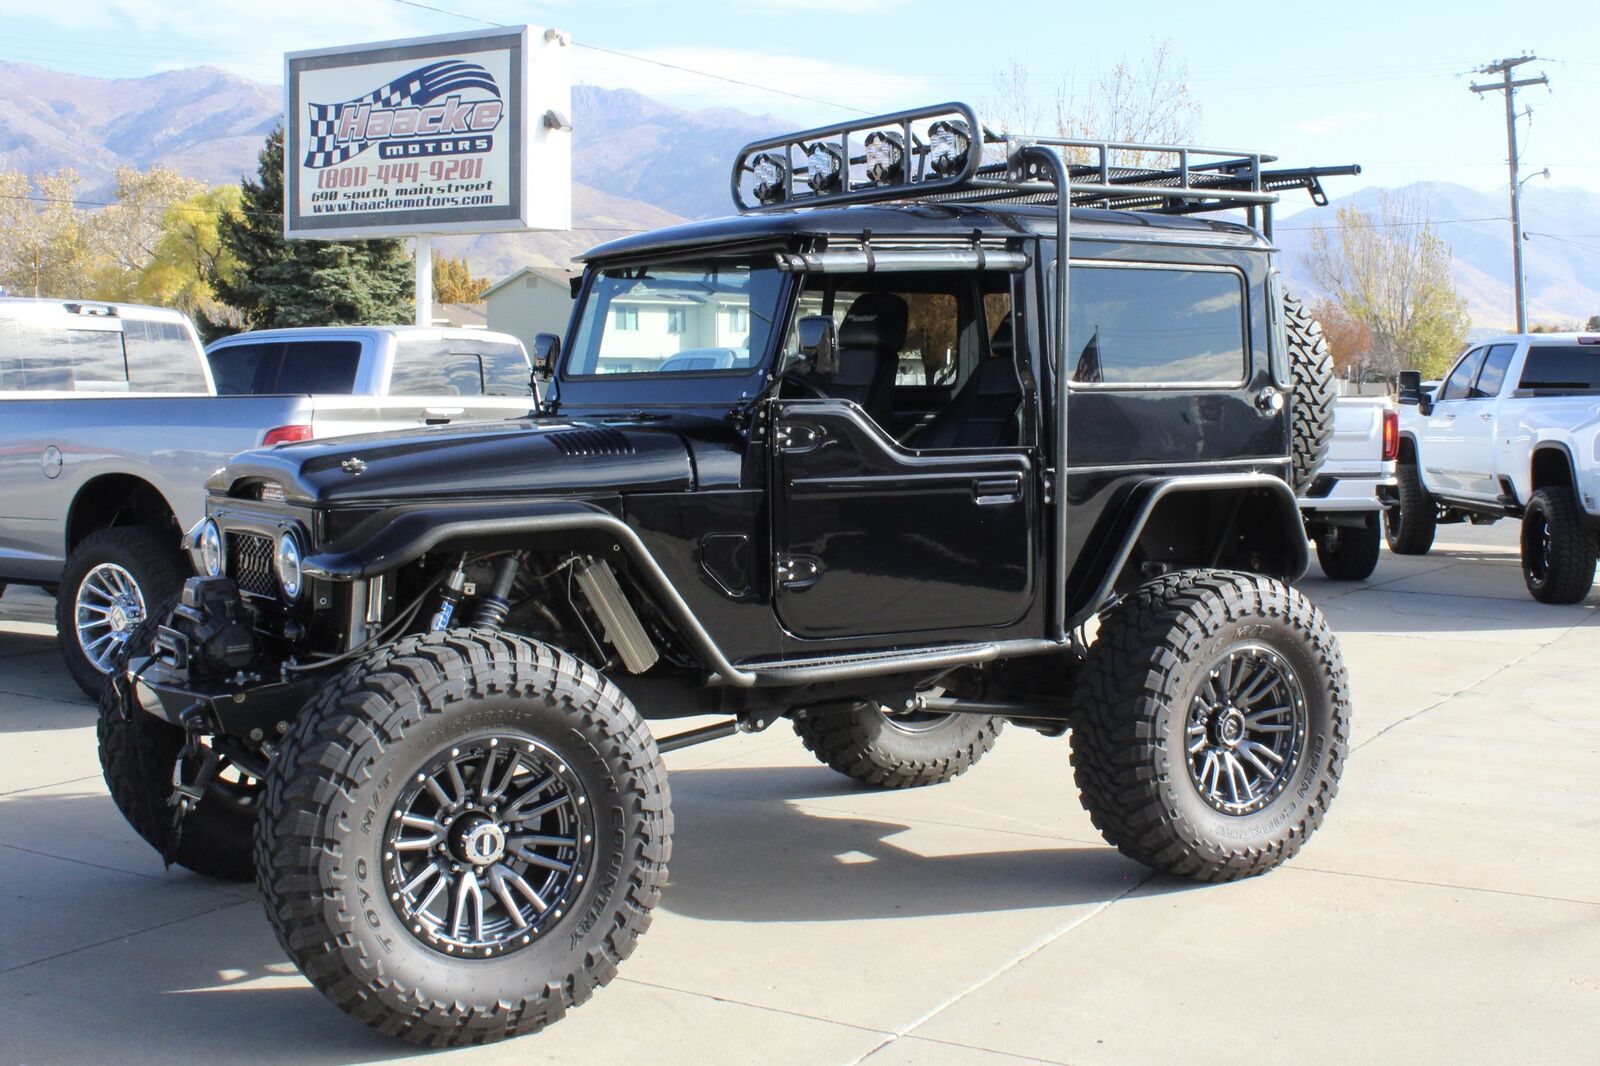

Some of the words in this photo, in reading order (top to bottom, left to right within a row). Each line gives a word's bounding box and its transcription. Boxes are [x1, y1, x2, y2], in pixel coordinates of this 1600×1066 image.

[336, 96, 502, 142] Haacke
[312, 191, 338, 202] 690
[343, 188, 388, 200] south
[395, 184, 433, 196] main
[437, 180, 493, 193] street
[317, 158, 483, 189] (801)-444-9201
[313, 194, 493, 213] www.haackemotors.com
[570, 805, 626, 951] COUNTRY
[355, 857, 393, 952] TOYO
